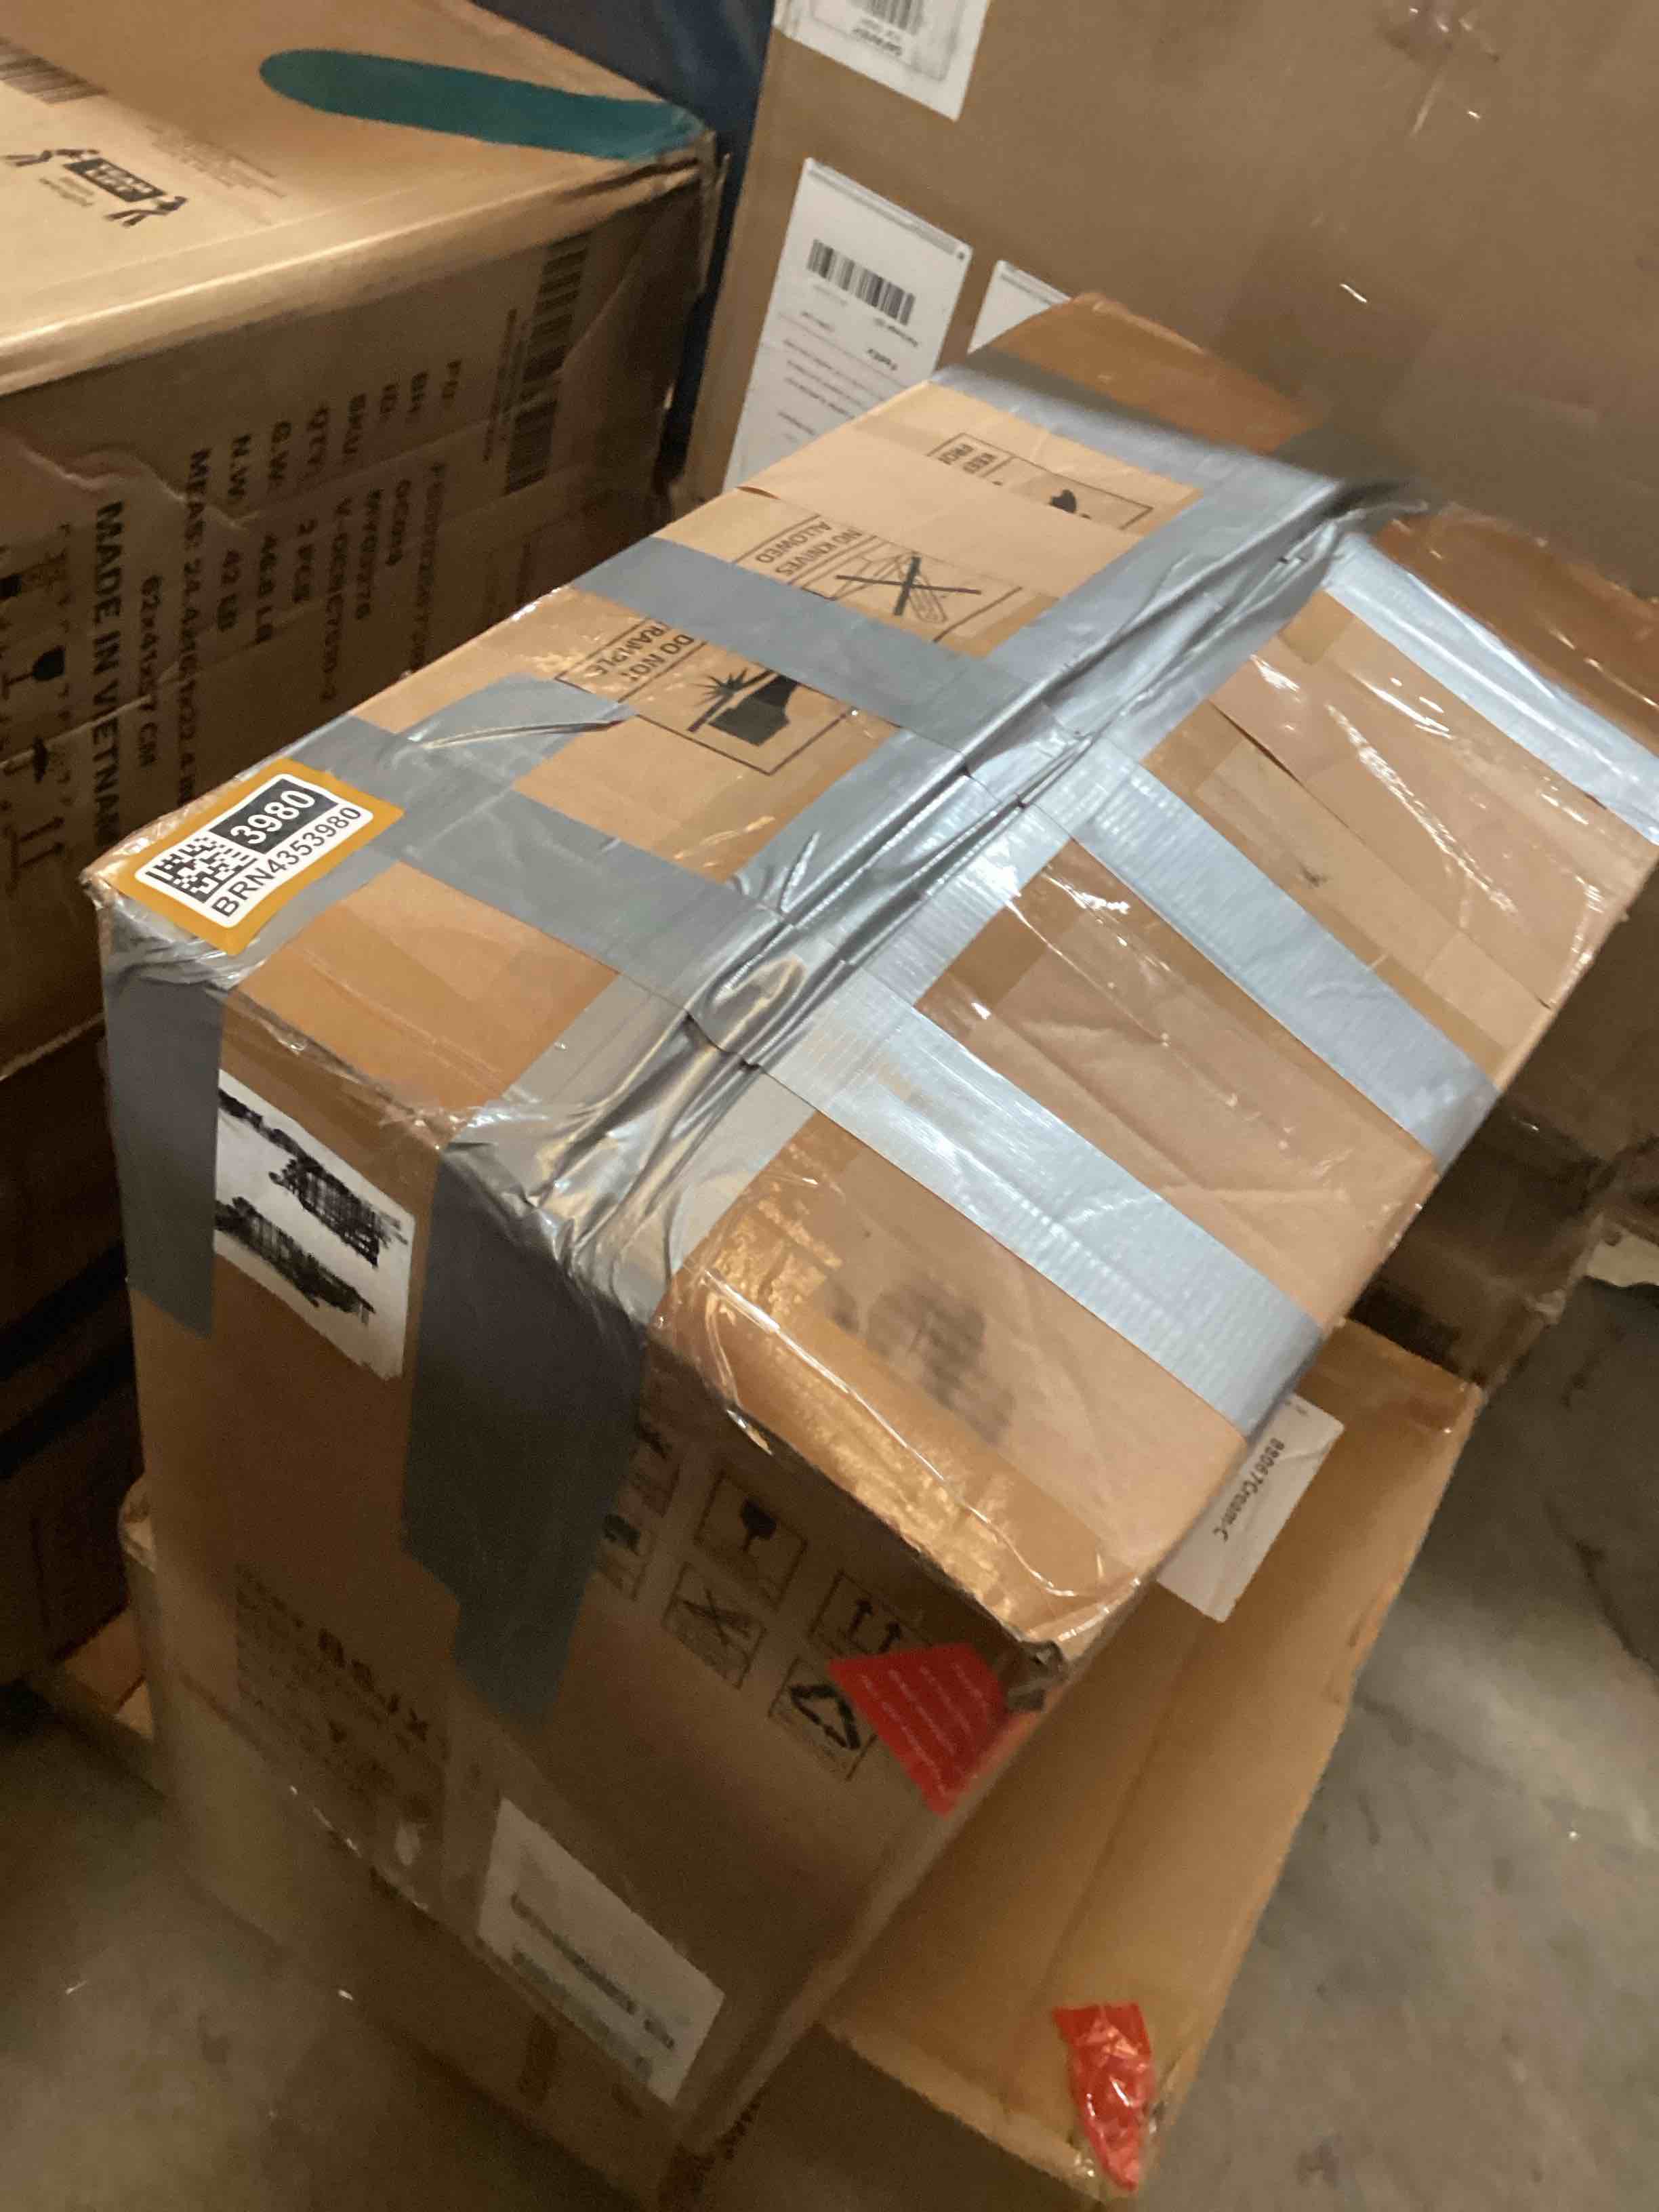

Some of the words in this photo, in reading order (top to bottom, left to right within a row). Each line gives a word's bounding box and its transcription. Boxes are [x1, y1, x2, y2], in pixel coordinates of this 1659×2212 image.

[755, 521, 832, 564] ALLOWED
[776, 542, 838, 575] KNIVES
[832, 529, 862, 543] NO
[94, 500, 124, 625] MADE
[93, 630, 121, 675] IN
[660, 634, 694, 654] DO
[92, 679, 120, 846] VIETNAM
[230, 789, 315, 846] 3980
[212, 806, 361, 917] BRN4353980
